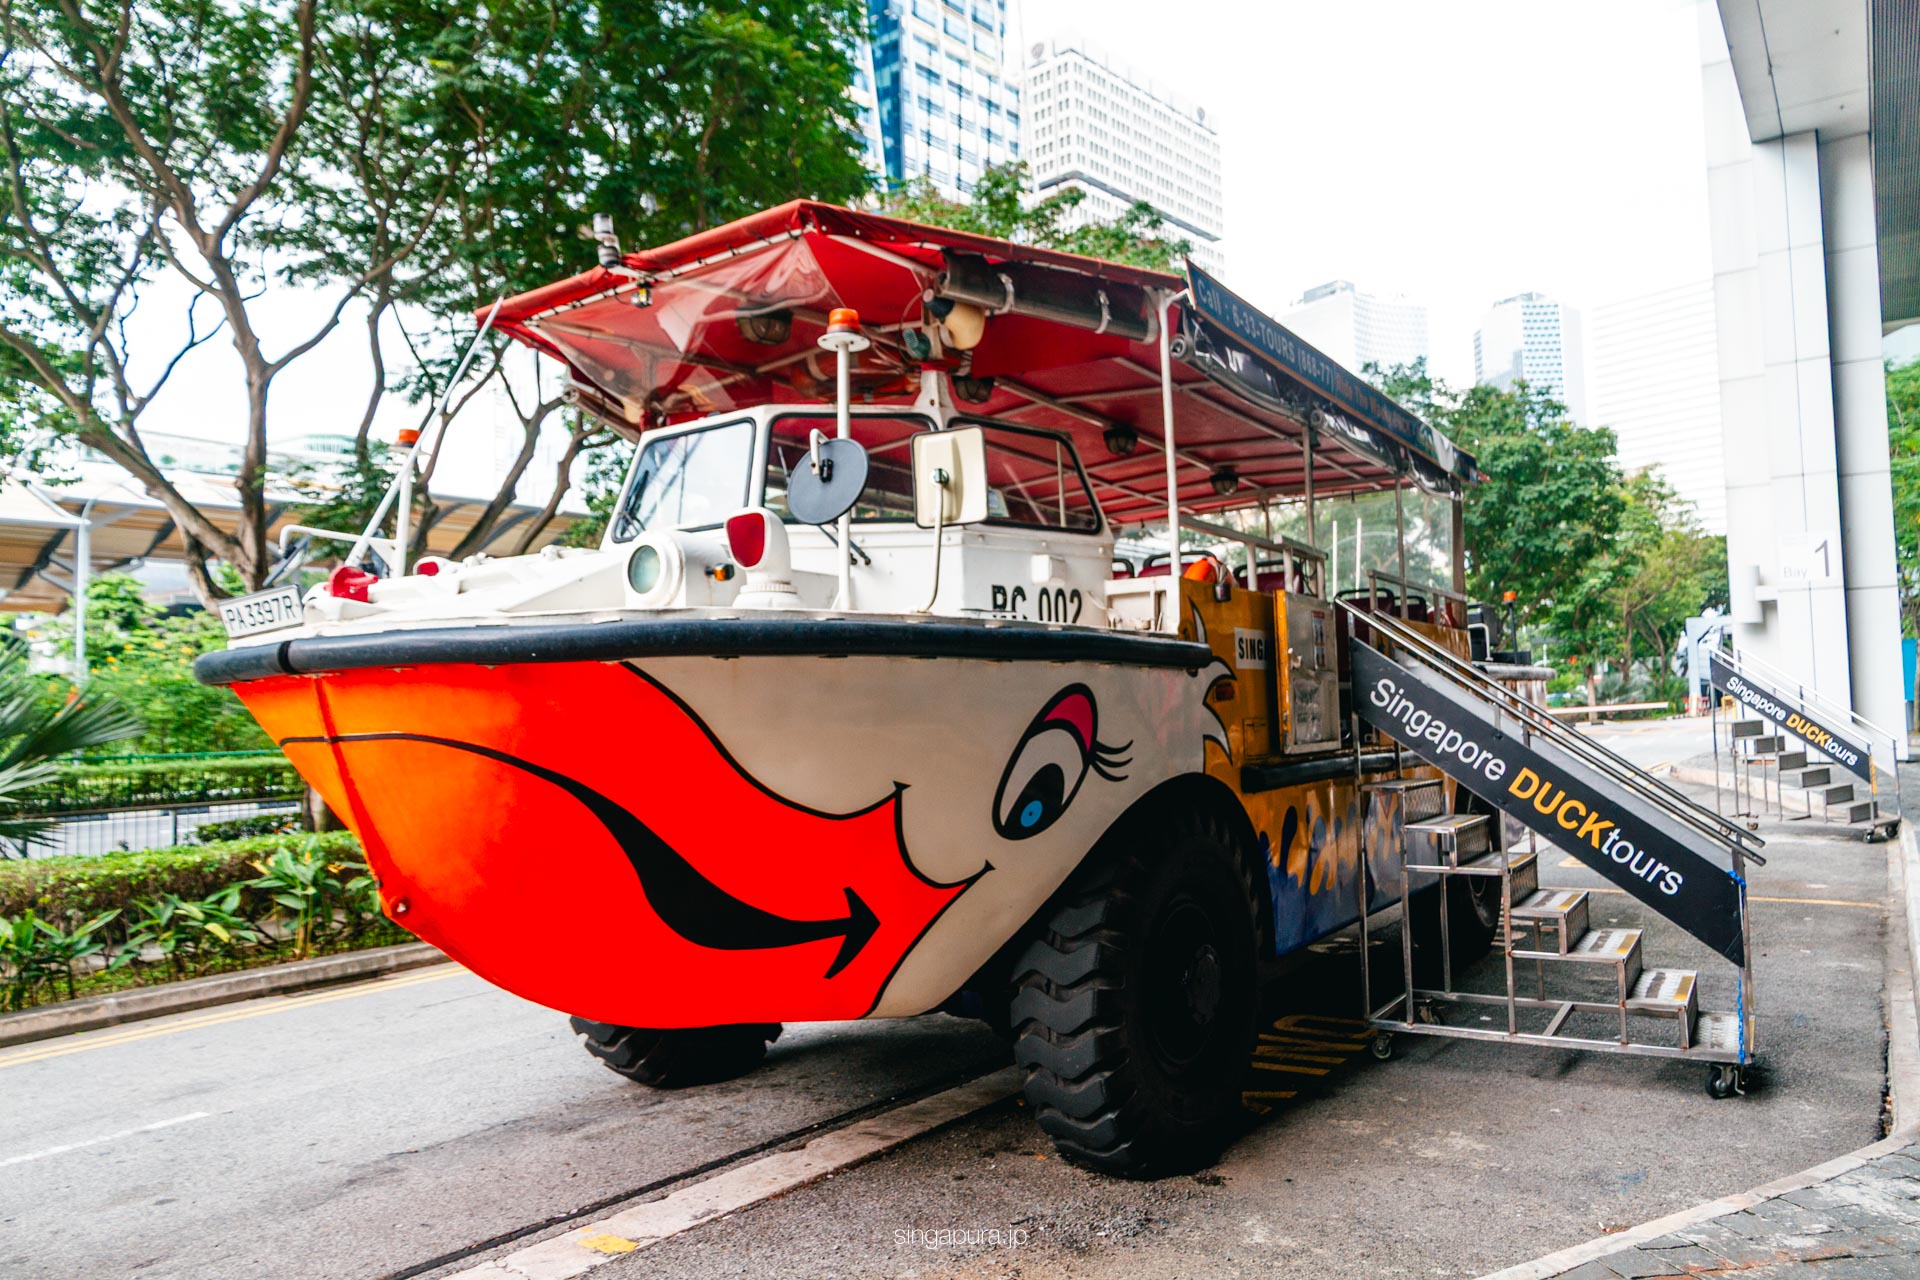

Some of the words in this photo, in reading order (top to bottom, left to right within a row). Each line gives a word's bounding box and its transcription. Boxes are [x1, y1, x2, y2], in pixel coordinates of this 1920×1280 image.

[1197, 278, 1222, 316] Call
[1232, 304, 1296, 363] 6-33-TOURS
[1784, 566, 1808, 579] Bay
[1814, 539, 1830, 577] 1
[226, 594, 296, 631] PA3397R
[1038, 587, 1082, 624] 002
[1237, 636, 1268, 661] SING
[1726, 676, 1787, 721] Singapore
[1785, 713, 1859, 766] DUCKtours
[1369, 678, 1507, 781] Singapore
[1508, 767, 1684, 896] DUCKtours
